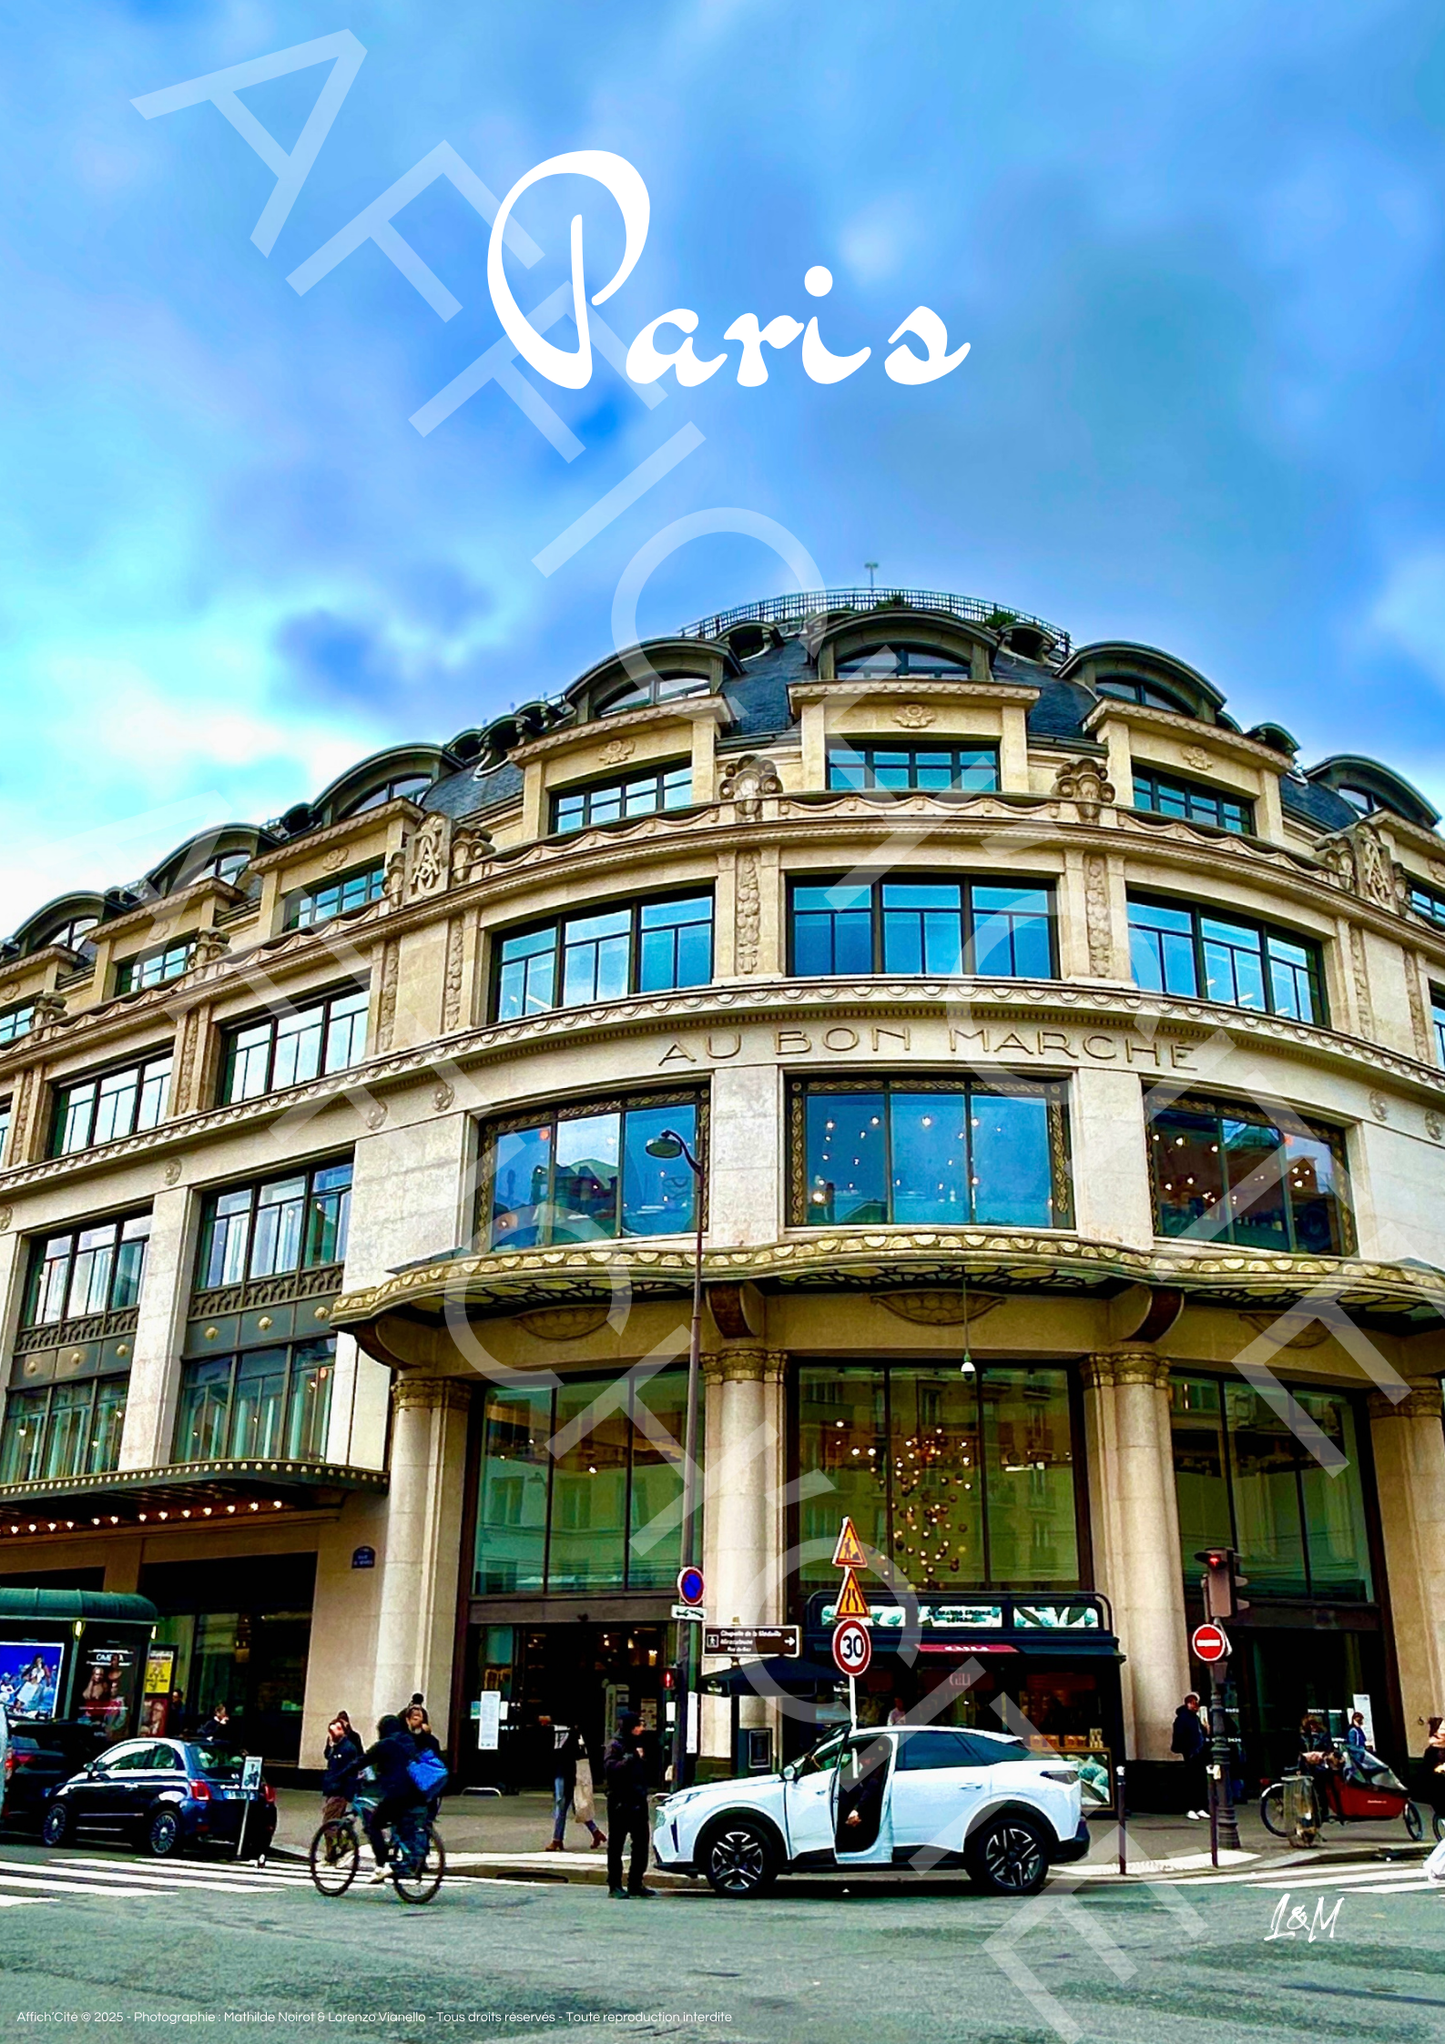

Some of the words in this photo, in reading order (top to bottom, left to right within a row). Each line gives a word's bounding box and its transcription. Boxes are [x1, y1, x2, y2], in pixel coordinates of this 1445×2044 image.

[658, 1034, 742, 1067] AU
[773, 1025, 911, 1056] BON
[842, 1635, 864, 1658] 30
